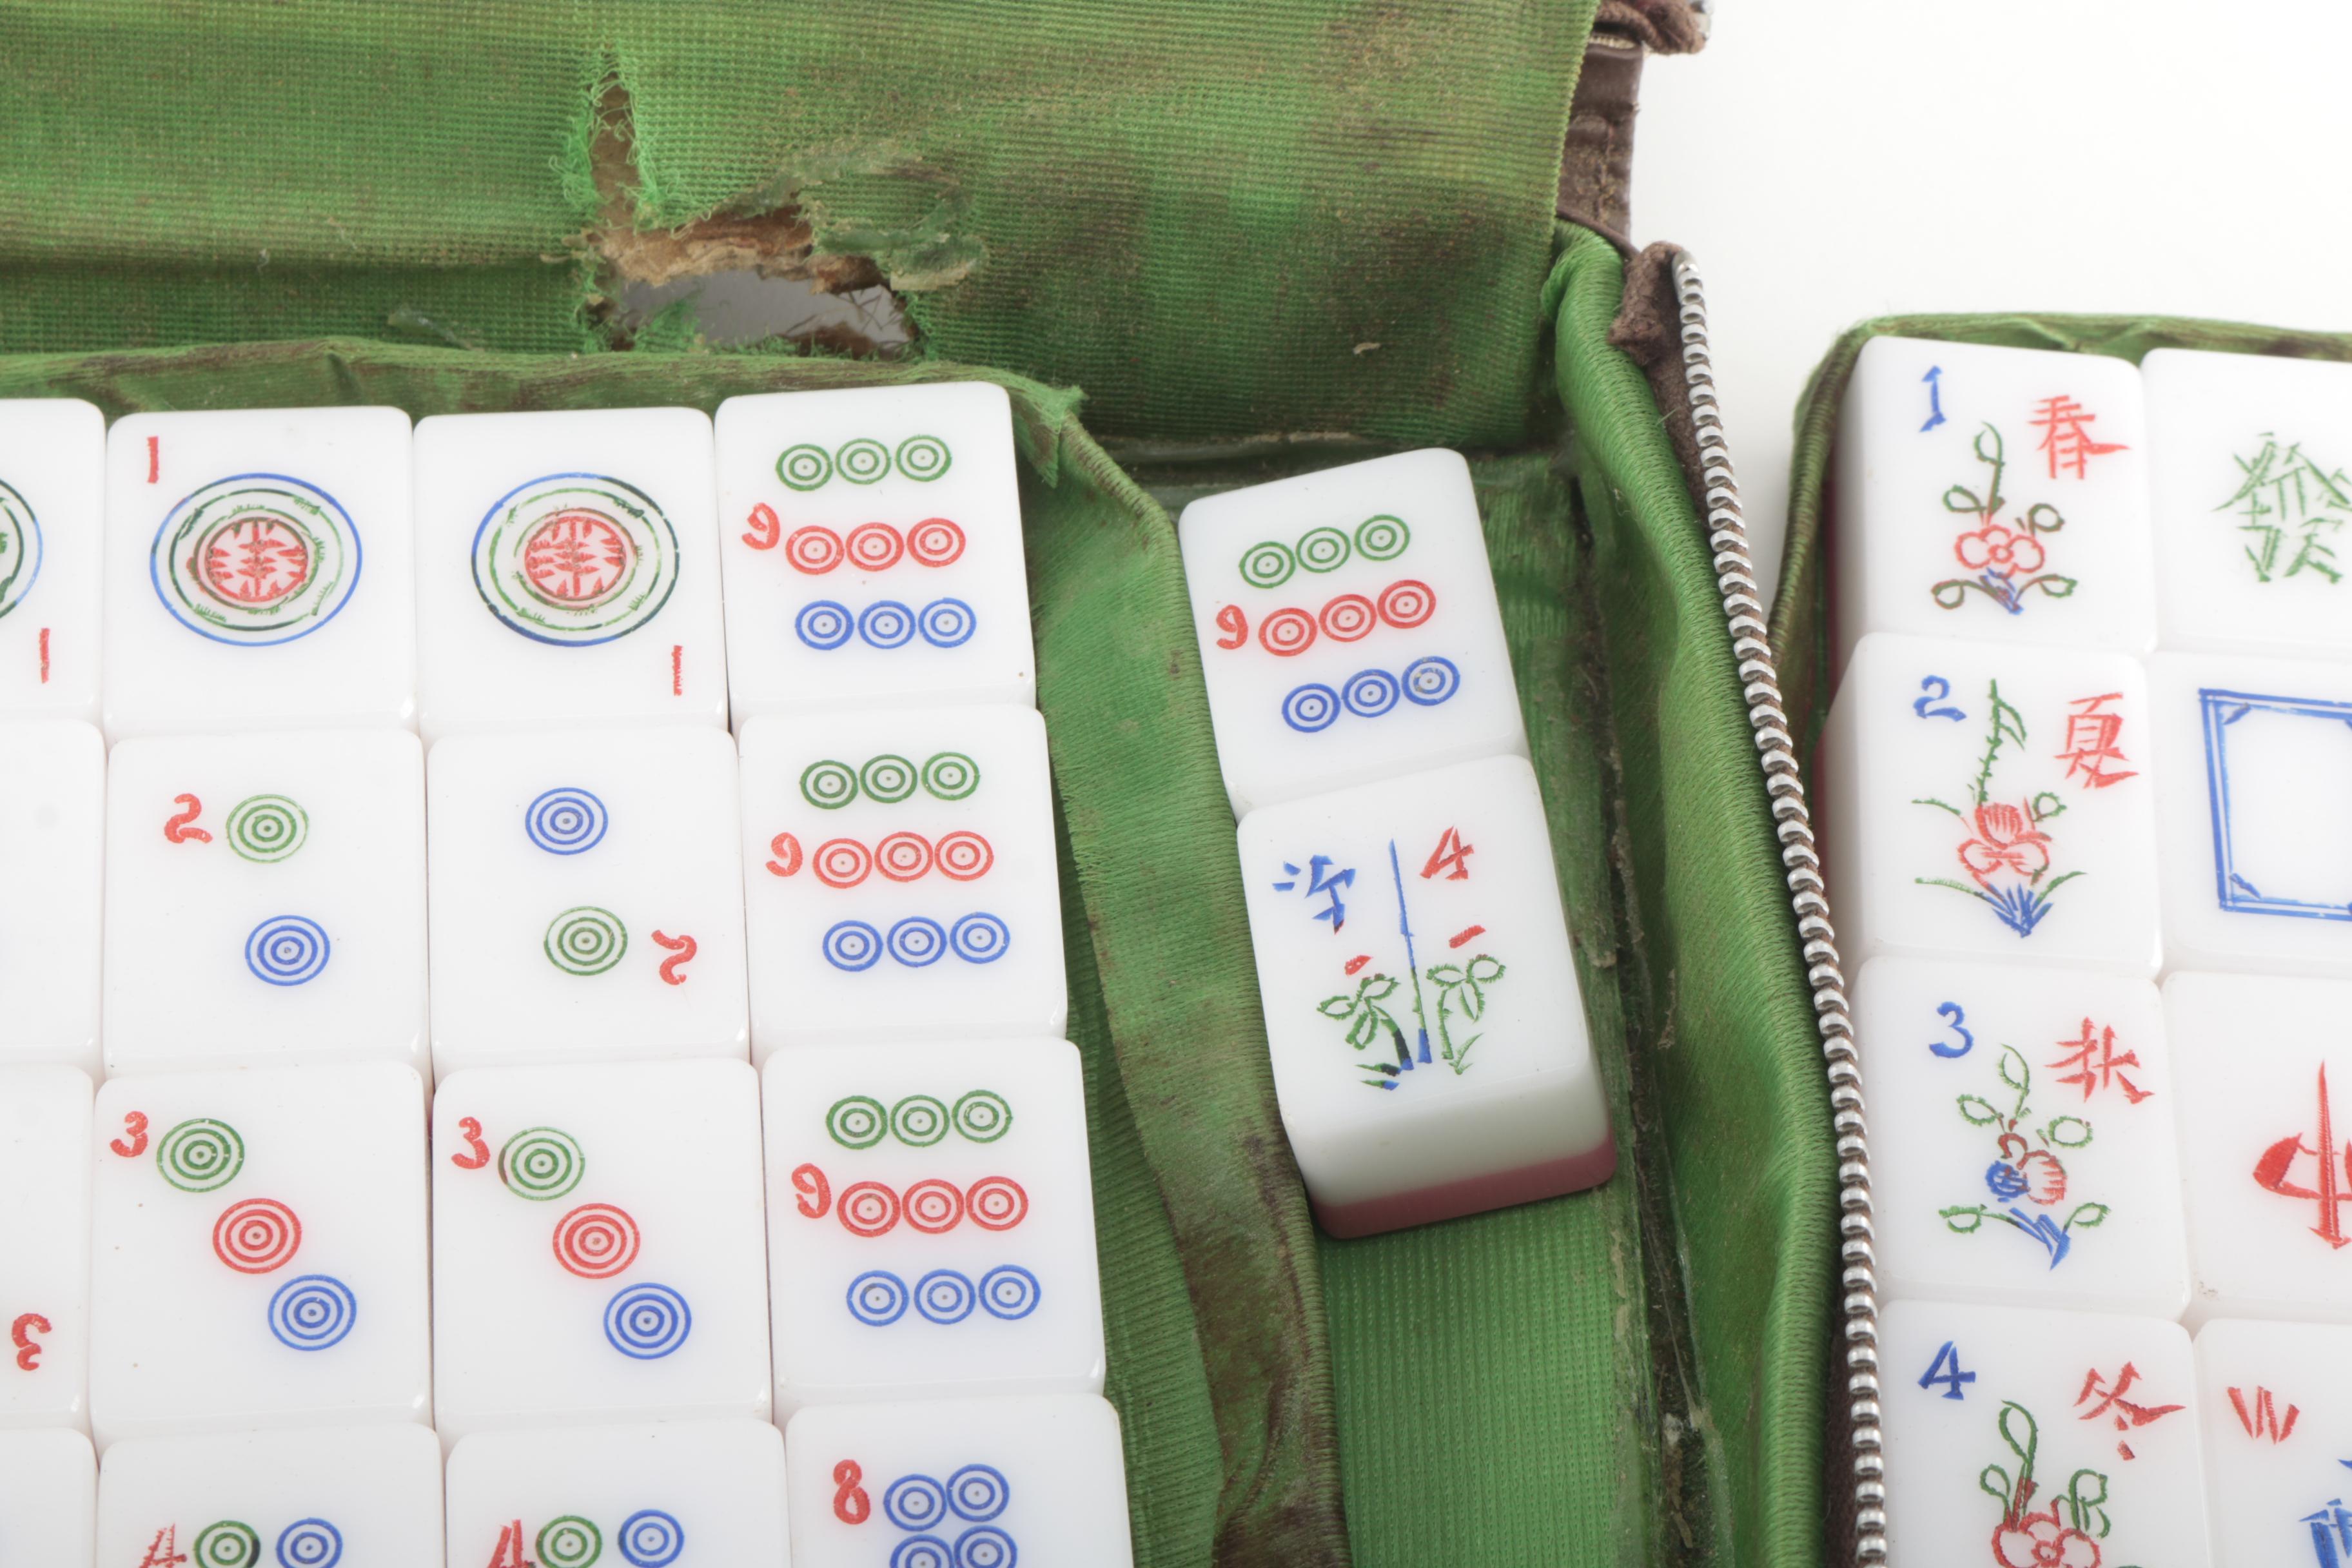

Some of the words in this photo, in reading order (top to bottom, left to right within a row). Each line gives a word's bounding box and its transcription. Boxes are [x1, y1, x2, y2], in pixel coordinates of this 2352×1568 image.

[1921, 365, 1946, 433] 1
[147, 435, 159, 484] 1
[2028, 394, 2131, 480] 春
[741, 502, 780, 551] 9
[1215, 603, 1248, 650] 9
[39, 628, 50, 683] 1
[671, 644, 683, 696] 1
[1913, 674, 1967, 722] 2
[2054, 692, 2139, 790] 夏
[164, 793, 213, 845] 2
[765, 832, 804, 877] 9
[1420, 826, 1475, 881] 4
[650, 929, 698, 987] 2
[1929, 1001, 1975, 1059] 3
[109, 1110, 149, 1159] 3
[451, 1116, 491, 1170] 3
[790, 1162, 832, 1220] 9
[10, 1312, 52, 1372] 3
[1918, 1340, 1977, 1401] 4
[2073, 1361, 2186, 1462] 冬
[2226, 1386, 2300, 1445] W
[832, 1458, 871, 1525] 8
